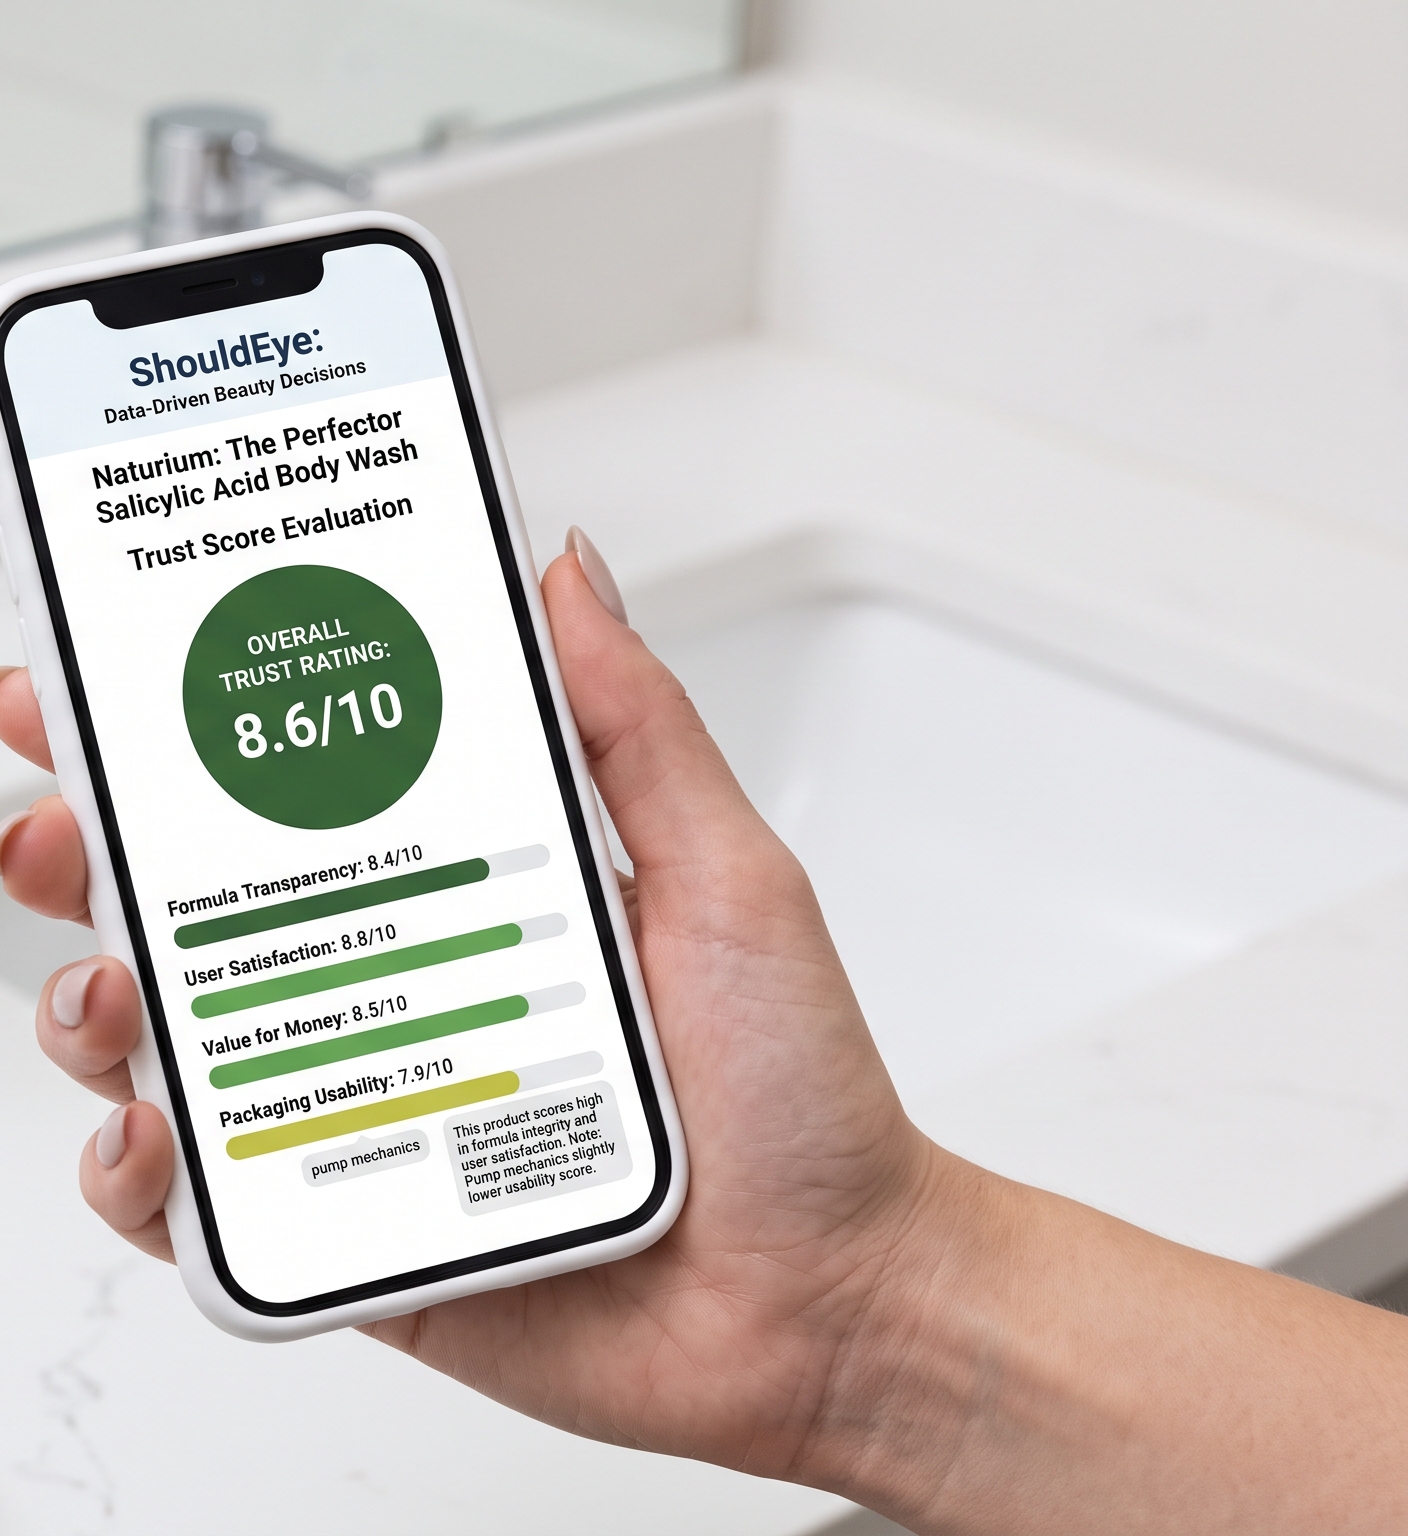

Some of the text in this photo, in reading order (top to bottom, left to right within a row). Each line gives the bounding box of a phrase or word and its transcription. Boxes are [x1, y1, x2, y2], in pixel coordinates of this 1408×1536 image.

[129, 328, 324, 387] ShouldEye:
[103, 361, 367, 425] Data-Driven Beauty Decisions
[91, 410, 402, 490] Naturium: The Perfector
[95, 437, 419, 524] Salicylic Acid Body Wash
[126, 497, 414, 571] Trust Score Evaluation
[218, 640, 391, 693] TRUST RATING:
[247, 618, 350, 655] OVERALL
[233, 683, 403, 759] 8.6/10
[166, 844, 423, 918] Formula Transparency: 8.4/10
[183, 923, 397, 987] User Satisfaction: 8.8/10
[200, 994, 408, 1057] Value for Money: 8.5/10
[218, 1057, 454, 1128] Packaging Usability: 7.9/10
[452, 1091, 604, 1139] This product scores high
[311, 1141, 421, 1180] pump mechanics
[457, 1109, 598, 1156] in formula integrity and
[460, 1128, 602, 1172] user satisfaction. Note:
[463, 1140, 615, 1188] Pump mechanics slightly
[467, 1164, 596, 1204] lower usability score.
